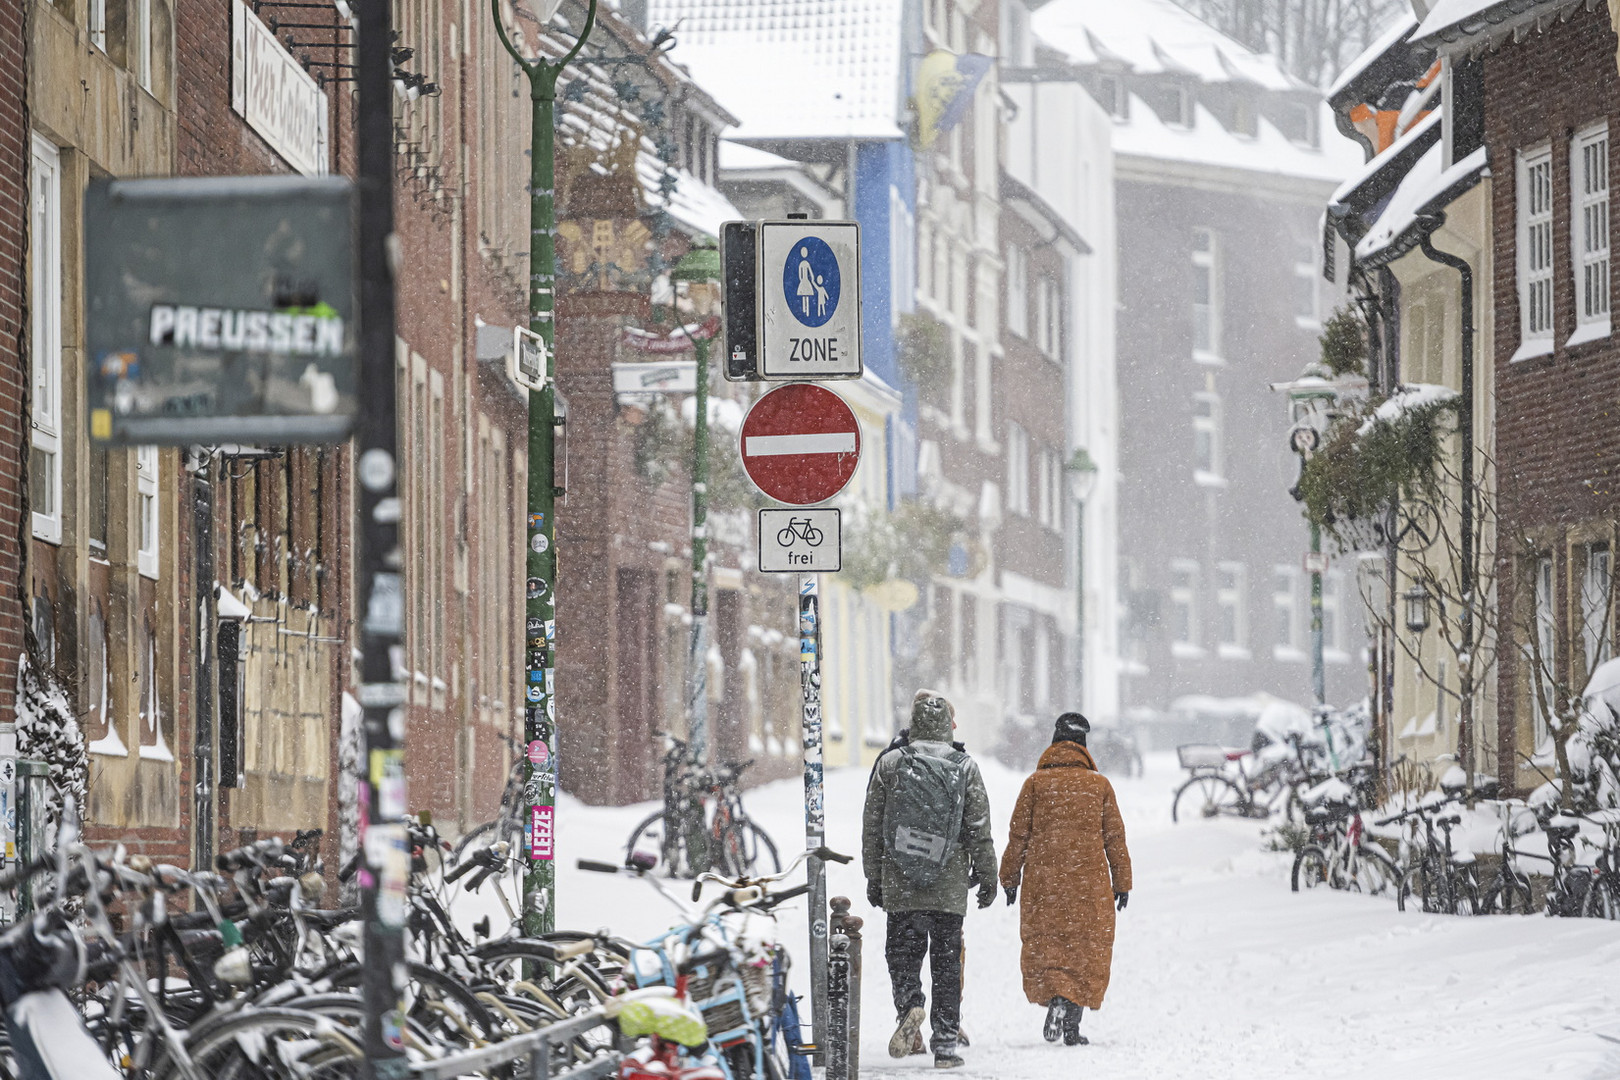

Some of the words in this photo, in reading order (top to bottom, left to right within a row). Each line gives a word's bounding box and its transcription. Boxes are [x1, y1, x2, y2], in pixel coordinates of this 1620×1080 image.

[151, 305, 344, 357] PREUSSEN
[789, 338, 838, 361] ZONE
[788, 551, 813, 564] frei
[533, 811, 551, 855] LEEZE
